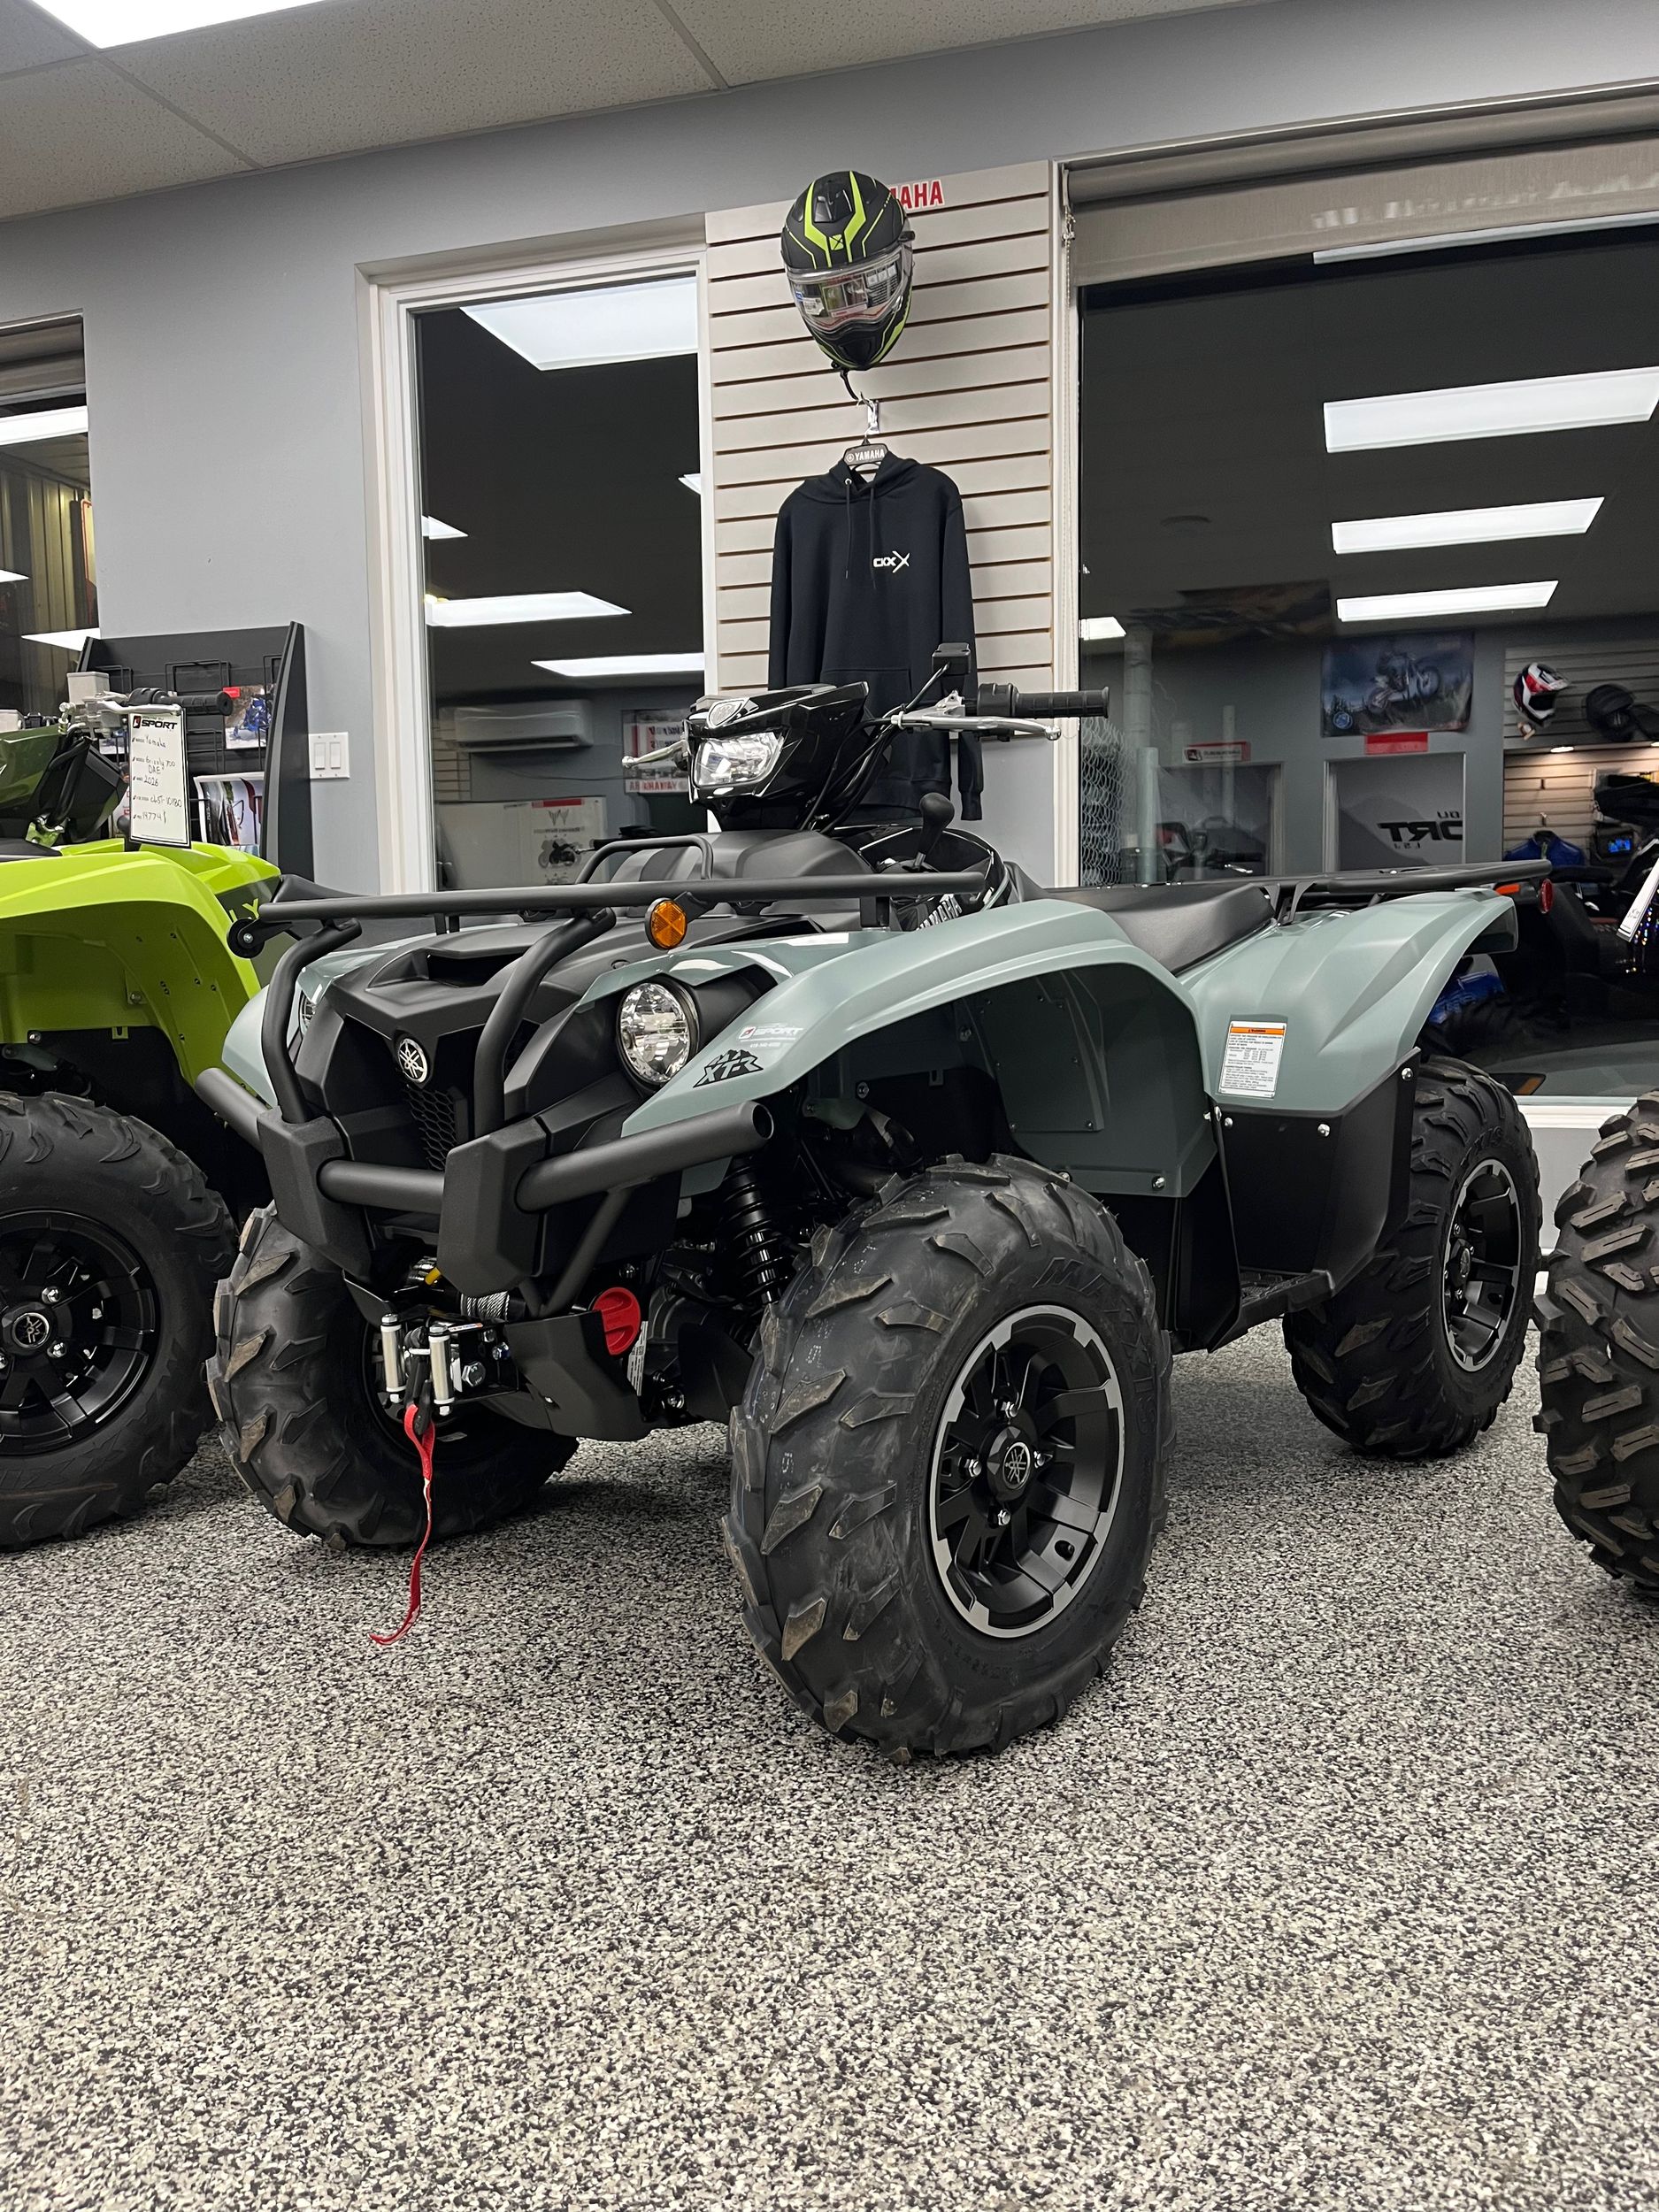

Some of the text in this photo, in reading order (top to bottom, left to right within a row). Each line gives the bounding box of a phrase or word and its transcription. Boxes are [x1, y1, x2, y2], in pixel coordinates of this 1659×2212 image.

[889, 180, 944, 209] AHA
[855, 448, 885, 461] YAMAHA
[142, 720, 177, 729] SPORT
